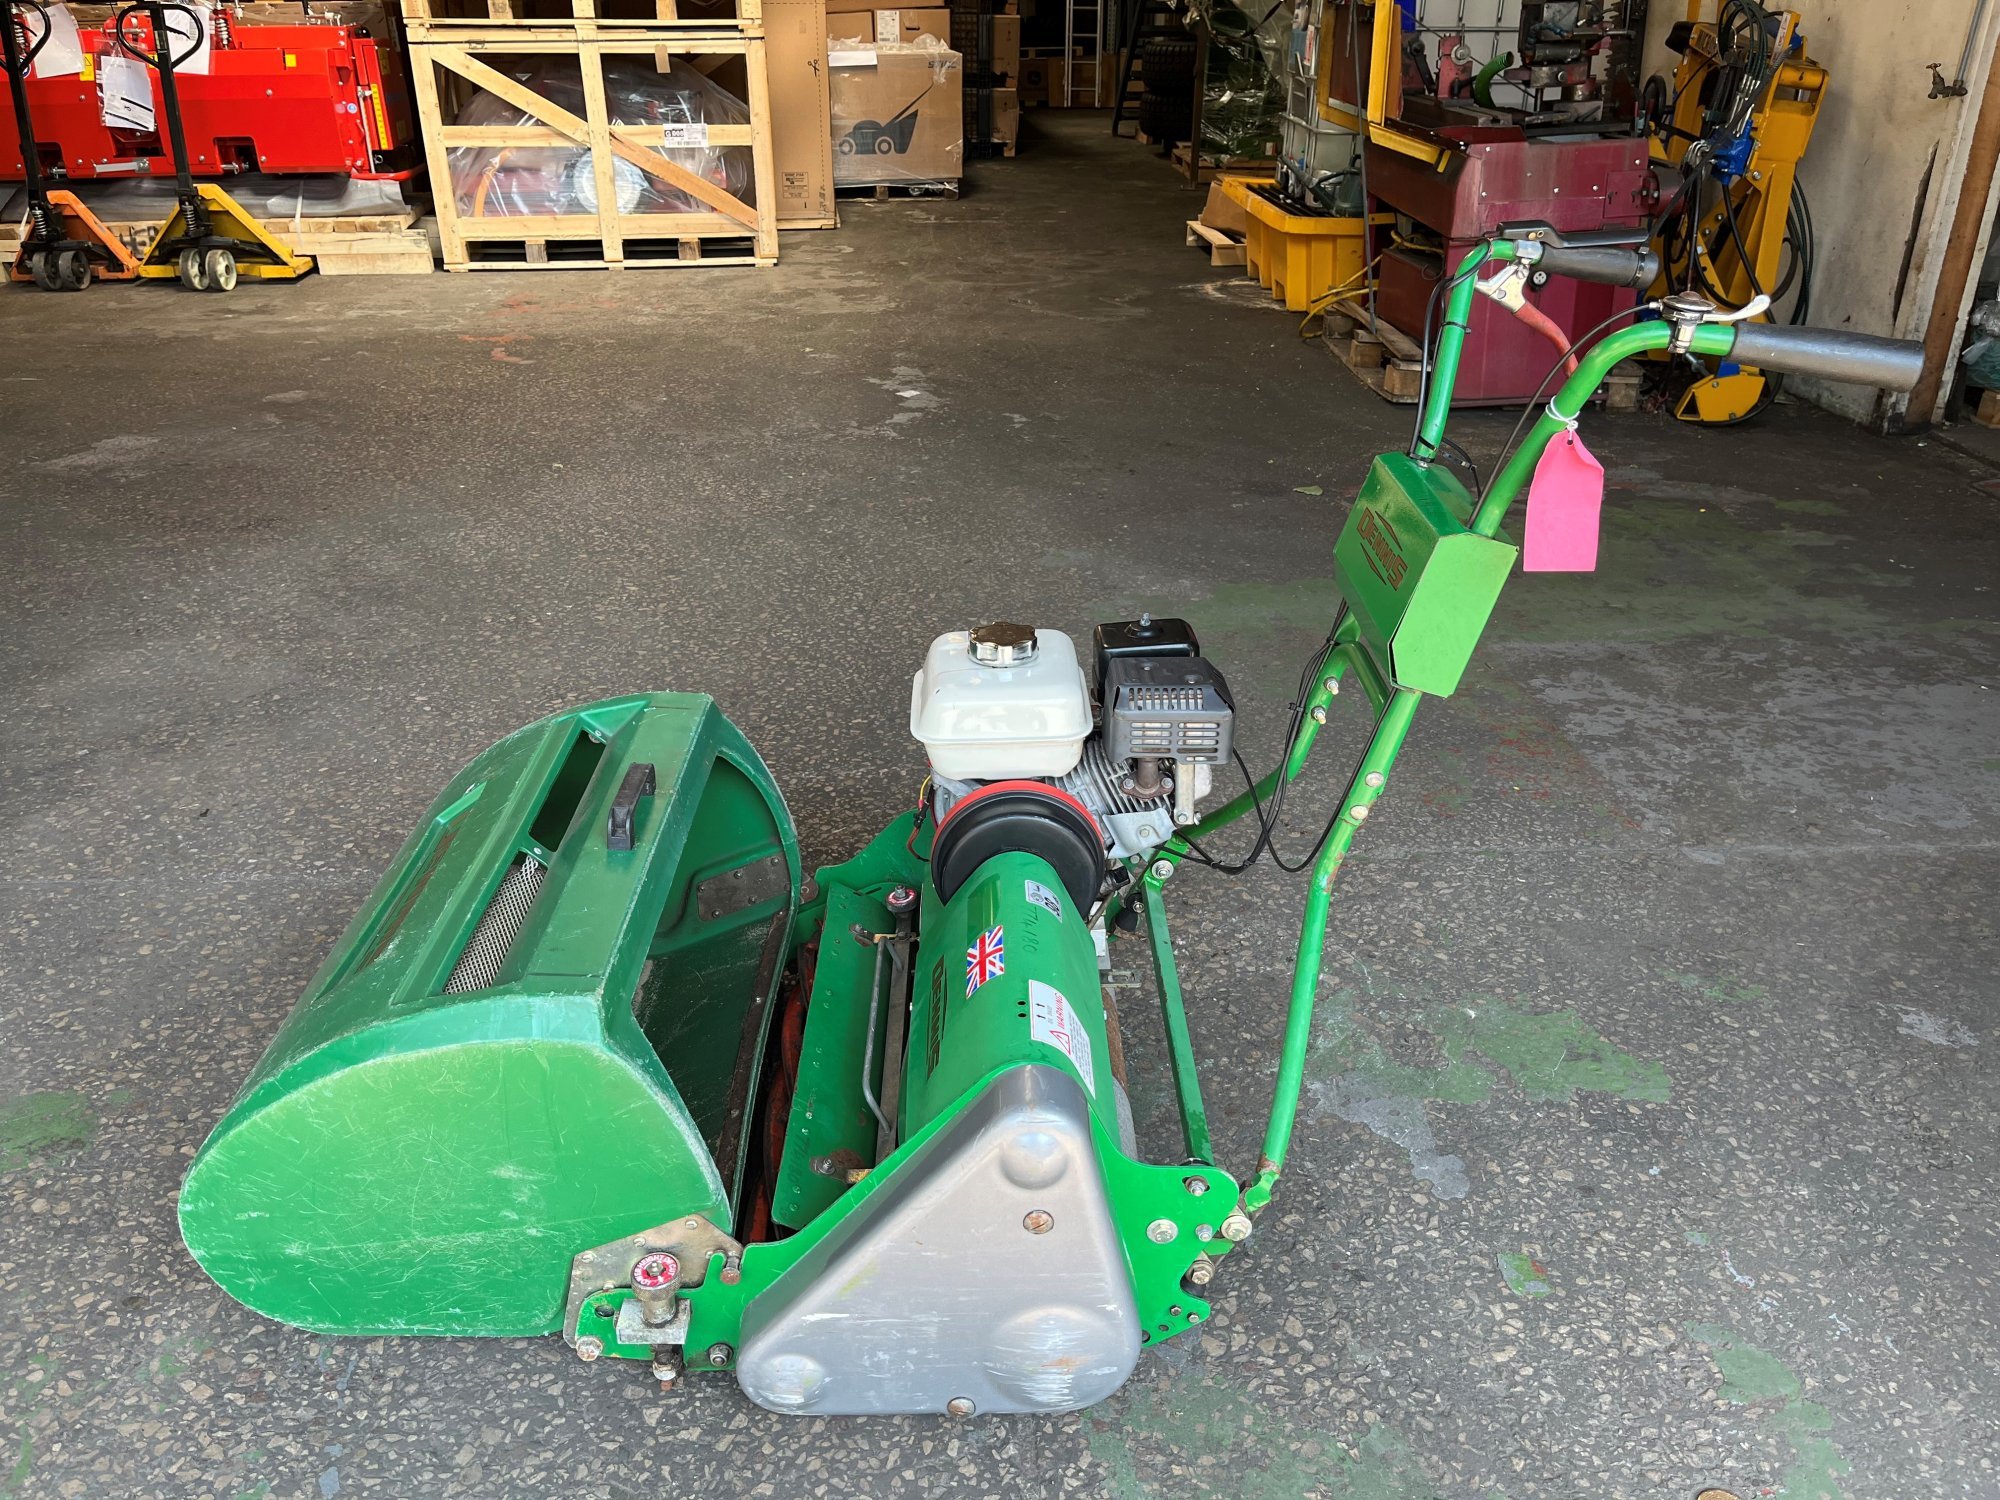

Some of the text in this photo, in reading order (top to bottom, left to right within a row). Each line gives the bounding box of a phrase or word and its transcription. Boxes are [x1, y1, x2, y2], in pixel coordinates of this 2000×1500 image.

[1357, 507, 1408, 591] DENNIS
[1019, 906, 1039, 953] 774180
[927, 954, 945, 1081] DENNIS
[1054, 992, 1065, 1029] WARNING
